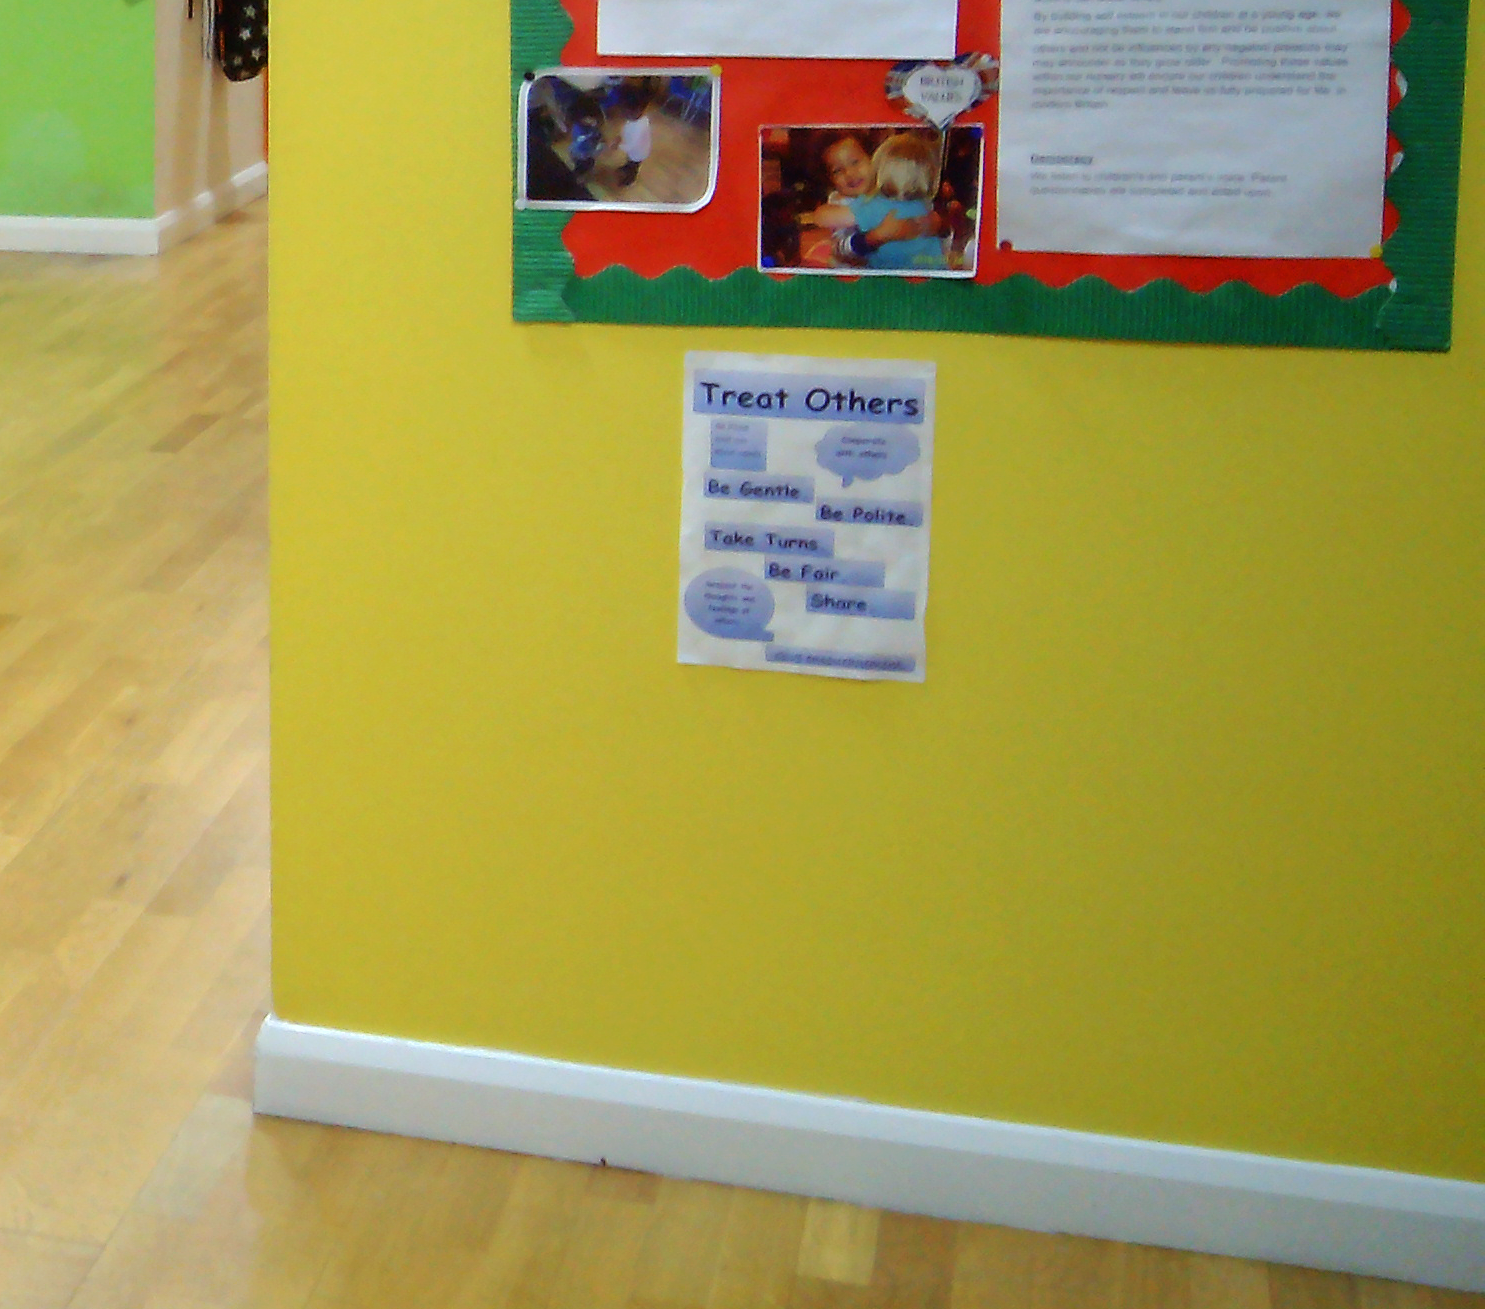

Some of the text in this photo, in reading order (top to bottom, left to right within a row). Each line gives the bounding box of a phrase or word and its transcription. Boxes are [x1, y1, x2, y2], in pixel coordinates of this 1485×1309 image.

[700, 382, 919, 417] Treat Others
[708, 479, 800, 499] Be Gentle
[820, 505, 907, 525] Be Polite
[710, 529, 818, 551] Take Turns
[769, 563, 839, 581] Be Fair
[811, 593, 867, 612] Share
